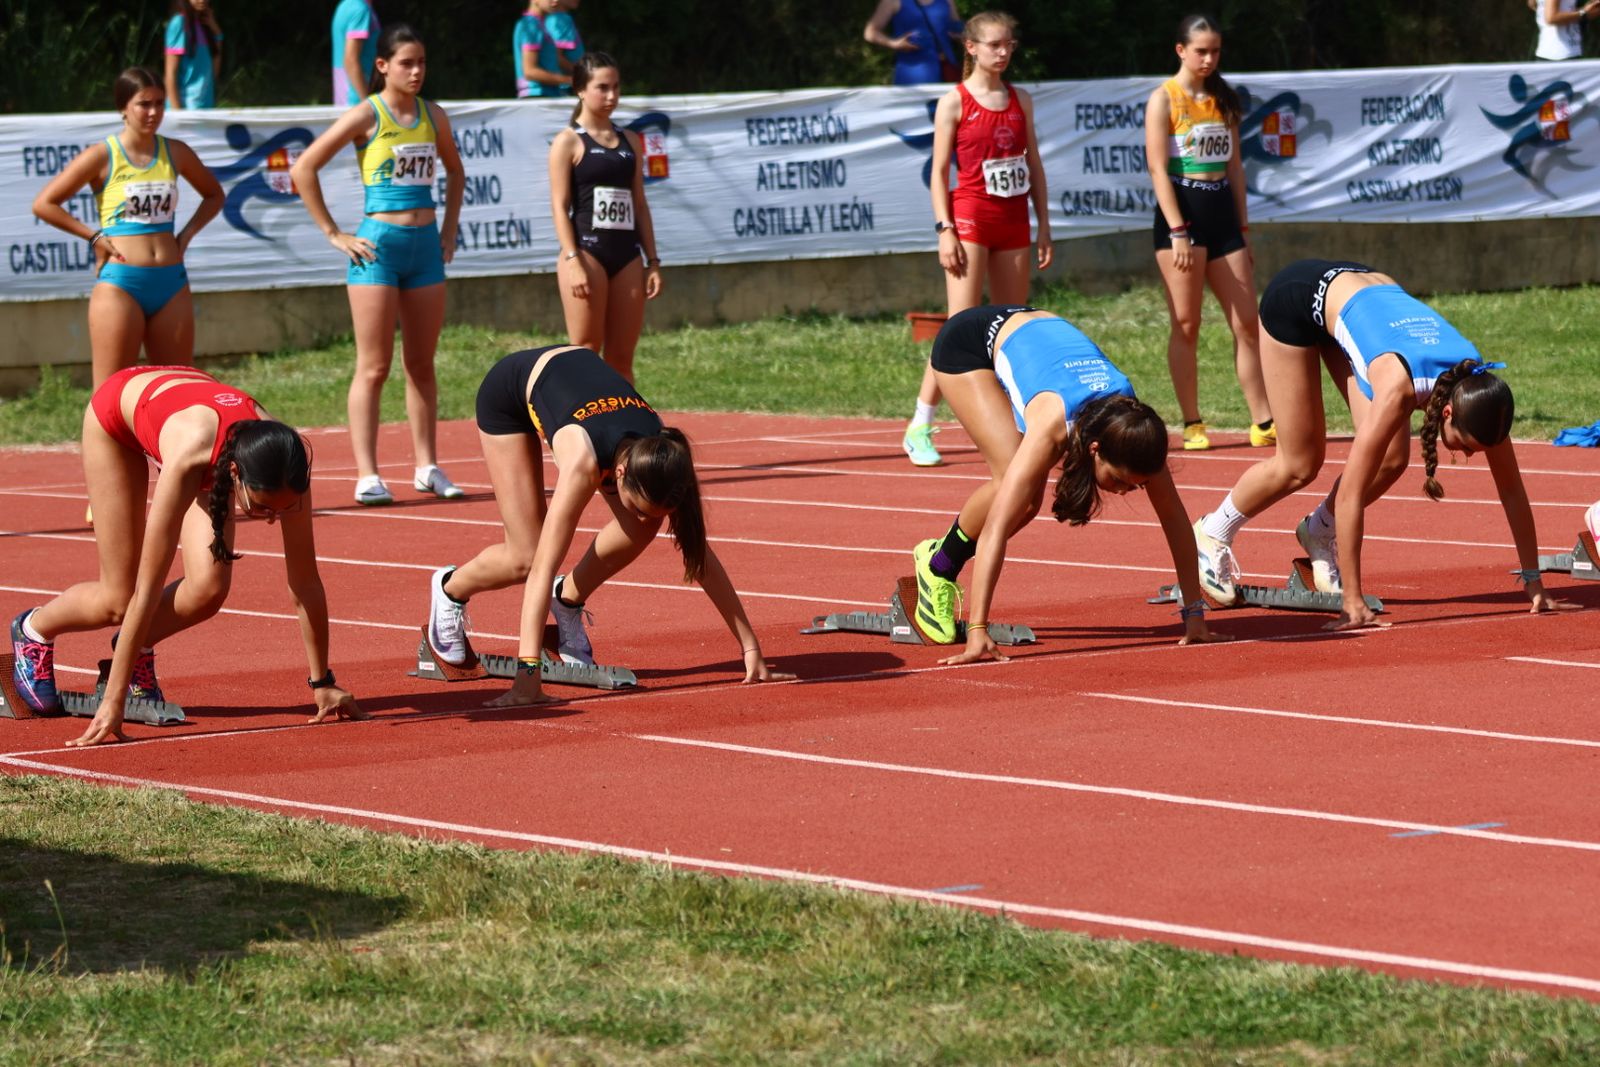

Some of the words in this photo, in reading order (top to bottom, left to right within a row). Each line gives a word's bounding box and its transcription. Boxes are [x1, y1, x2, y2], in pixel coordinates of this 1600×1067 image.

[1075, 102, 1147, 131] FEDERAC
[1361, 87, 1445, 126] FEDERACIÓN
[745, 107, 849, 146] FEDERACIÓN
[1083, 145, 1147, 174] ATLETIS
[1199, 135, 1229, 157] 1066
[1368, 138, 1443, 167] ATLETISMO
[396, 155, 434, 178] 3478
[757, 158, 846, 191] ATLETISMO
[990, 167, 1025, 192] 1519
[129, 193, 172, 217] 3474
[1061, 188, 1135, 216] CASTILLA
[1347, 180, 1413, 203] CASTILLA
[598, 200, 632, 223] 3691
[733, 205, 813, 237] CASTILLA
[814, 203, 826, 233] Y
[829, 195, 874, 232] LEÓN
[468, 220, 480, 250] Y
[484, 212, 531, 249] LEÓN
[1311, 278, 1329, 327] PRO
